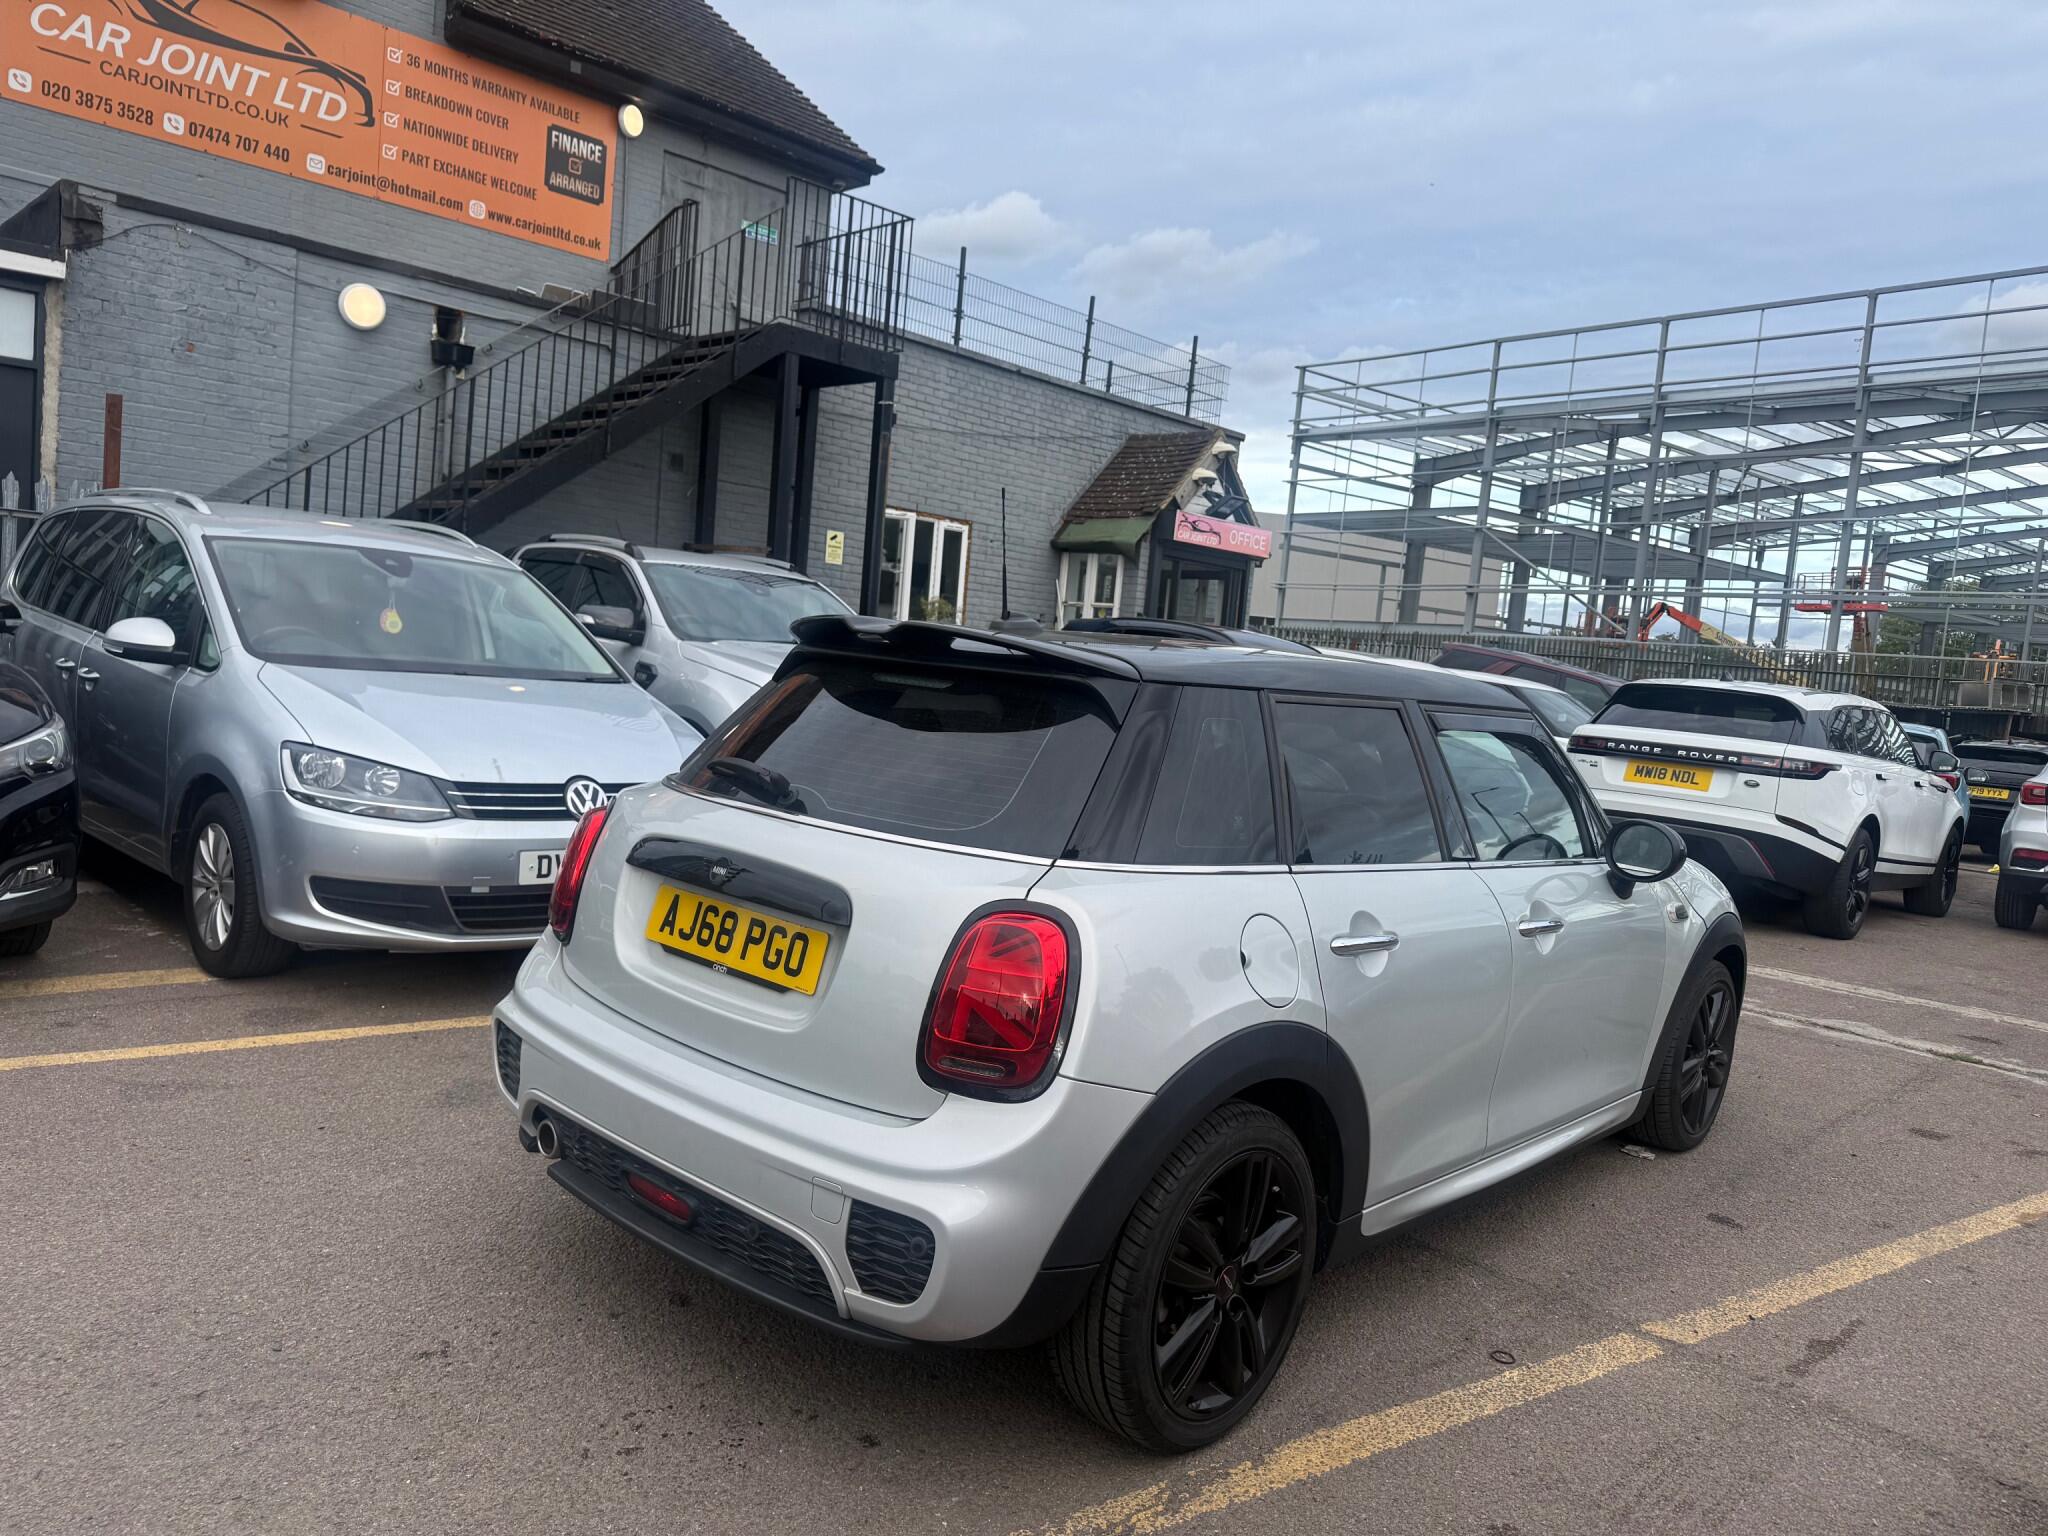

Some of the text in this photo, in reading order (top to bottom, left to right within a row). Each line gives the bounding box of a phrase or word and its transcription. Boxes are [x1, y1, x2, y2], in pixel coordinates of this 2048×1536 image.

[30, 3, 348, 122] CAR JOINT LTD
[41, 79, 154, 126] 020 3875 3528
[99, 60, 289, 128] CARJOINTLTD.CO.UK
[405, 85, 509, 130] BREAKDOWN COVER
[406, 53, 581, 124] 36 MONTHS WARRANTY AVAILABLE
[189, 121, 290, 163] 07474 707 440
[403, 117, 519, 164] NATIONWIDE DELIVERY
[551, 130, 603, 163] FINANCE
[327, 162, 463, 213] carjoint@hotmail.com
[401, 149, 537, 200] PART EXCHANGE WELCOME
[549, 171, 601, 199] ARRANGED
[488, 210, 601, 251] www.carjointltd.co.uk
[1178, 530, 1190, 539] CAR
[1207, 535, 1217, 545] LTD
[1229, 530, 1266, 550] OFFICE
[1607, 742, 1738, 763] RANGE ROVER
[1633, 765, 1699, 785] MW18 NDL
[712, 865, 727, 876] MINI
[658, 894, 810, 978] AJ68 PGO
[712, 963, 728, 974] cinch
